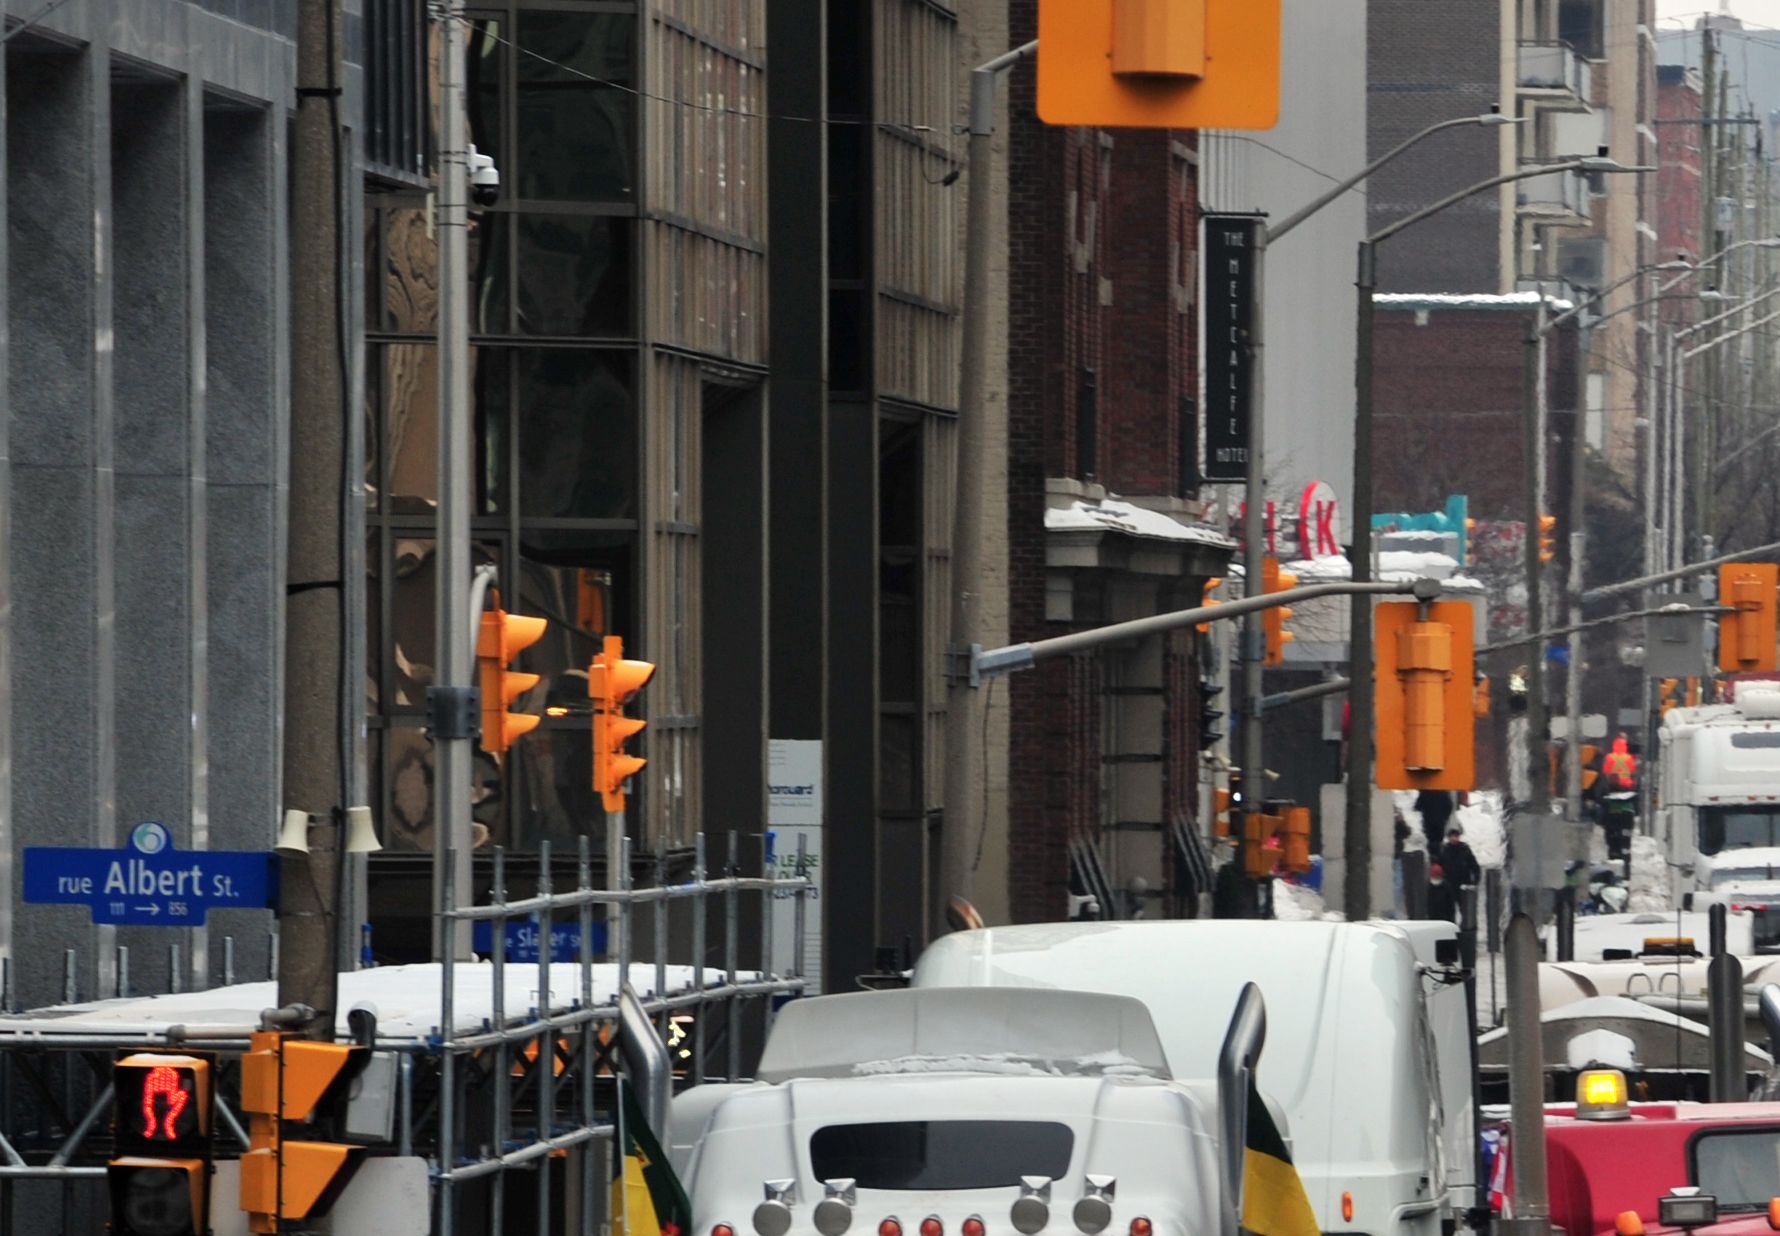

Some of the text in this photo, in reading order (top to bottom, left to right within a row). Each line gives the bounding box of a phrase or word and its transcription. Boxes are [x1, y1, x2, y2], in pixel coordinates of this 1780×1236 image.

[1229, 259, 1240, 435] METCALFE
[780, 854, 819, 868] LESE
[58, 860, 239, 897] rue Albert St.
[110, 902, 125, 916] 111
[516, 927, 567, 947] Slaer
